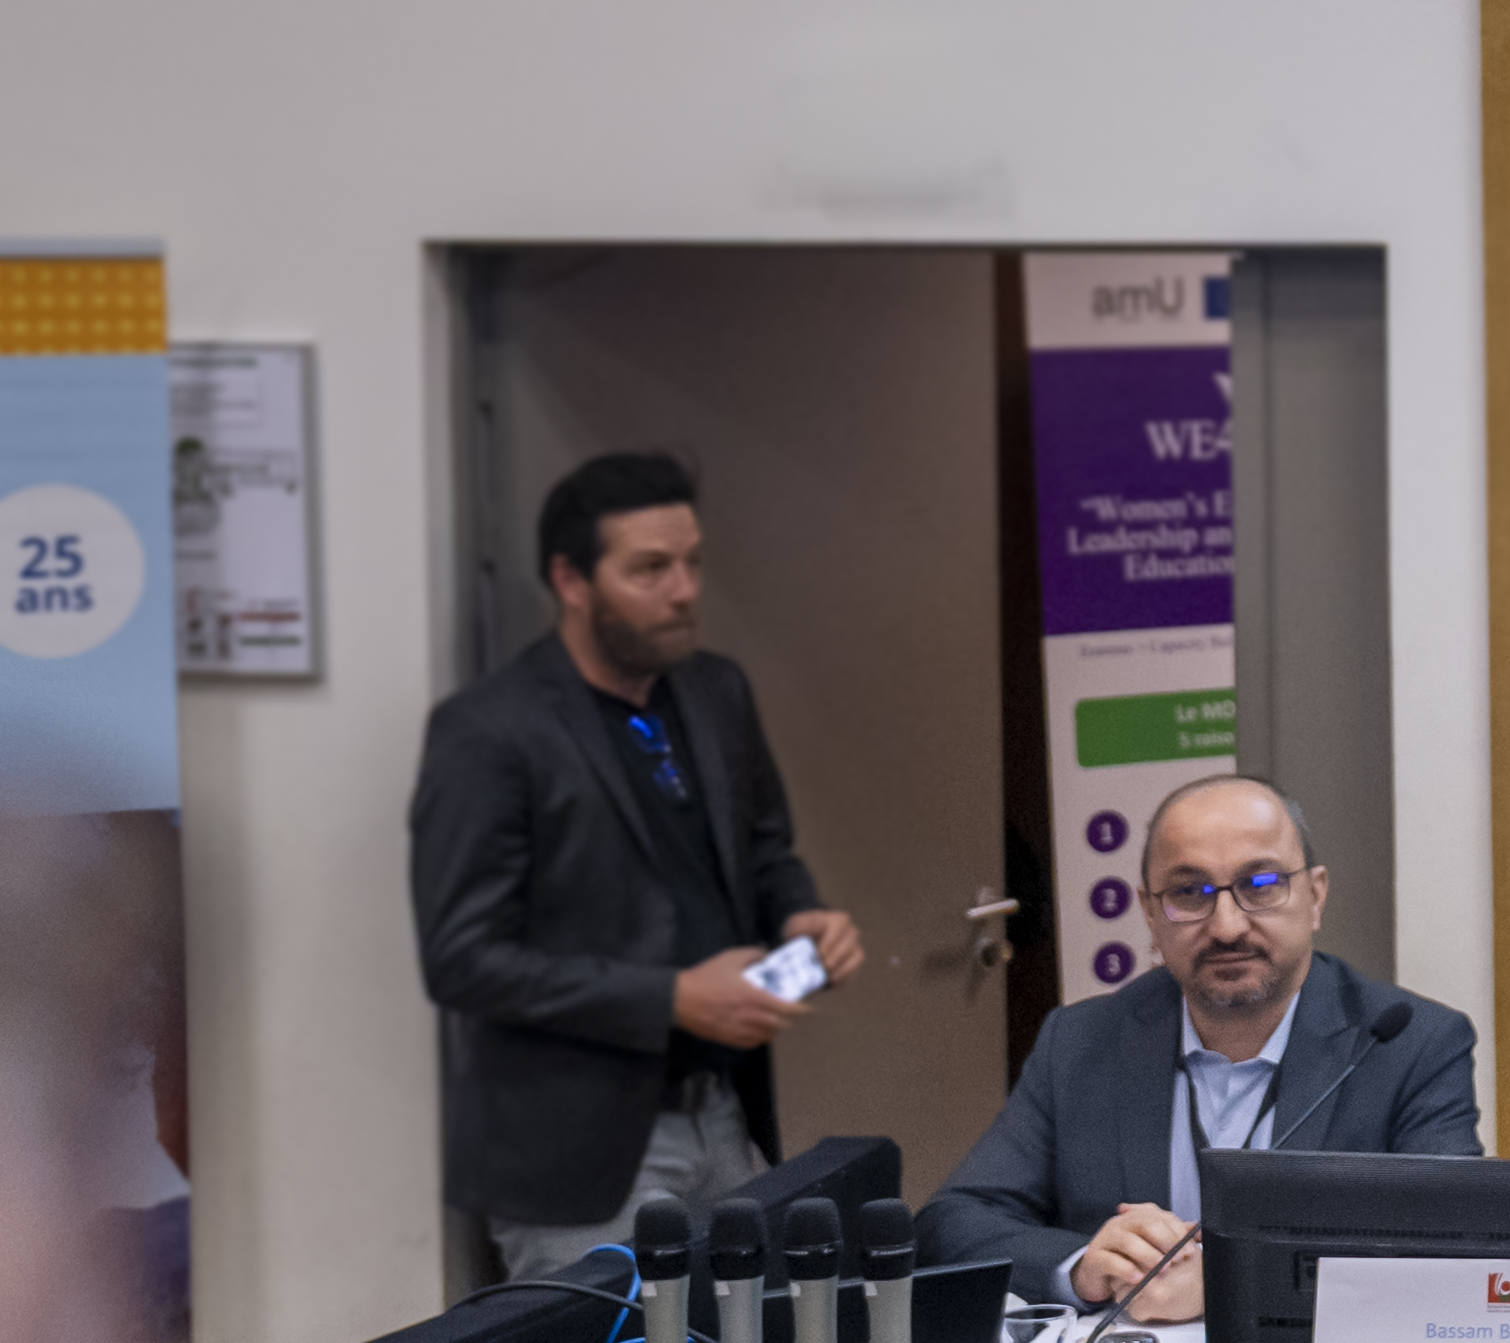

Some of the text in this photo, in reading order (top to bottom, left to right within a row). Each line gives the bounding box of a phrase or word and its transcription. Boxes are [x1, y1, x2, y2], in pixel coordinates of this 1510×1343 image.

[18, 535, 85, 580] 25
[15, 582, 93, 615] ans
[1426, 1323, 1493, 1339] Bassam
